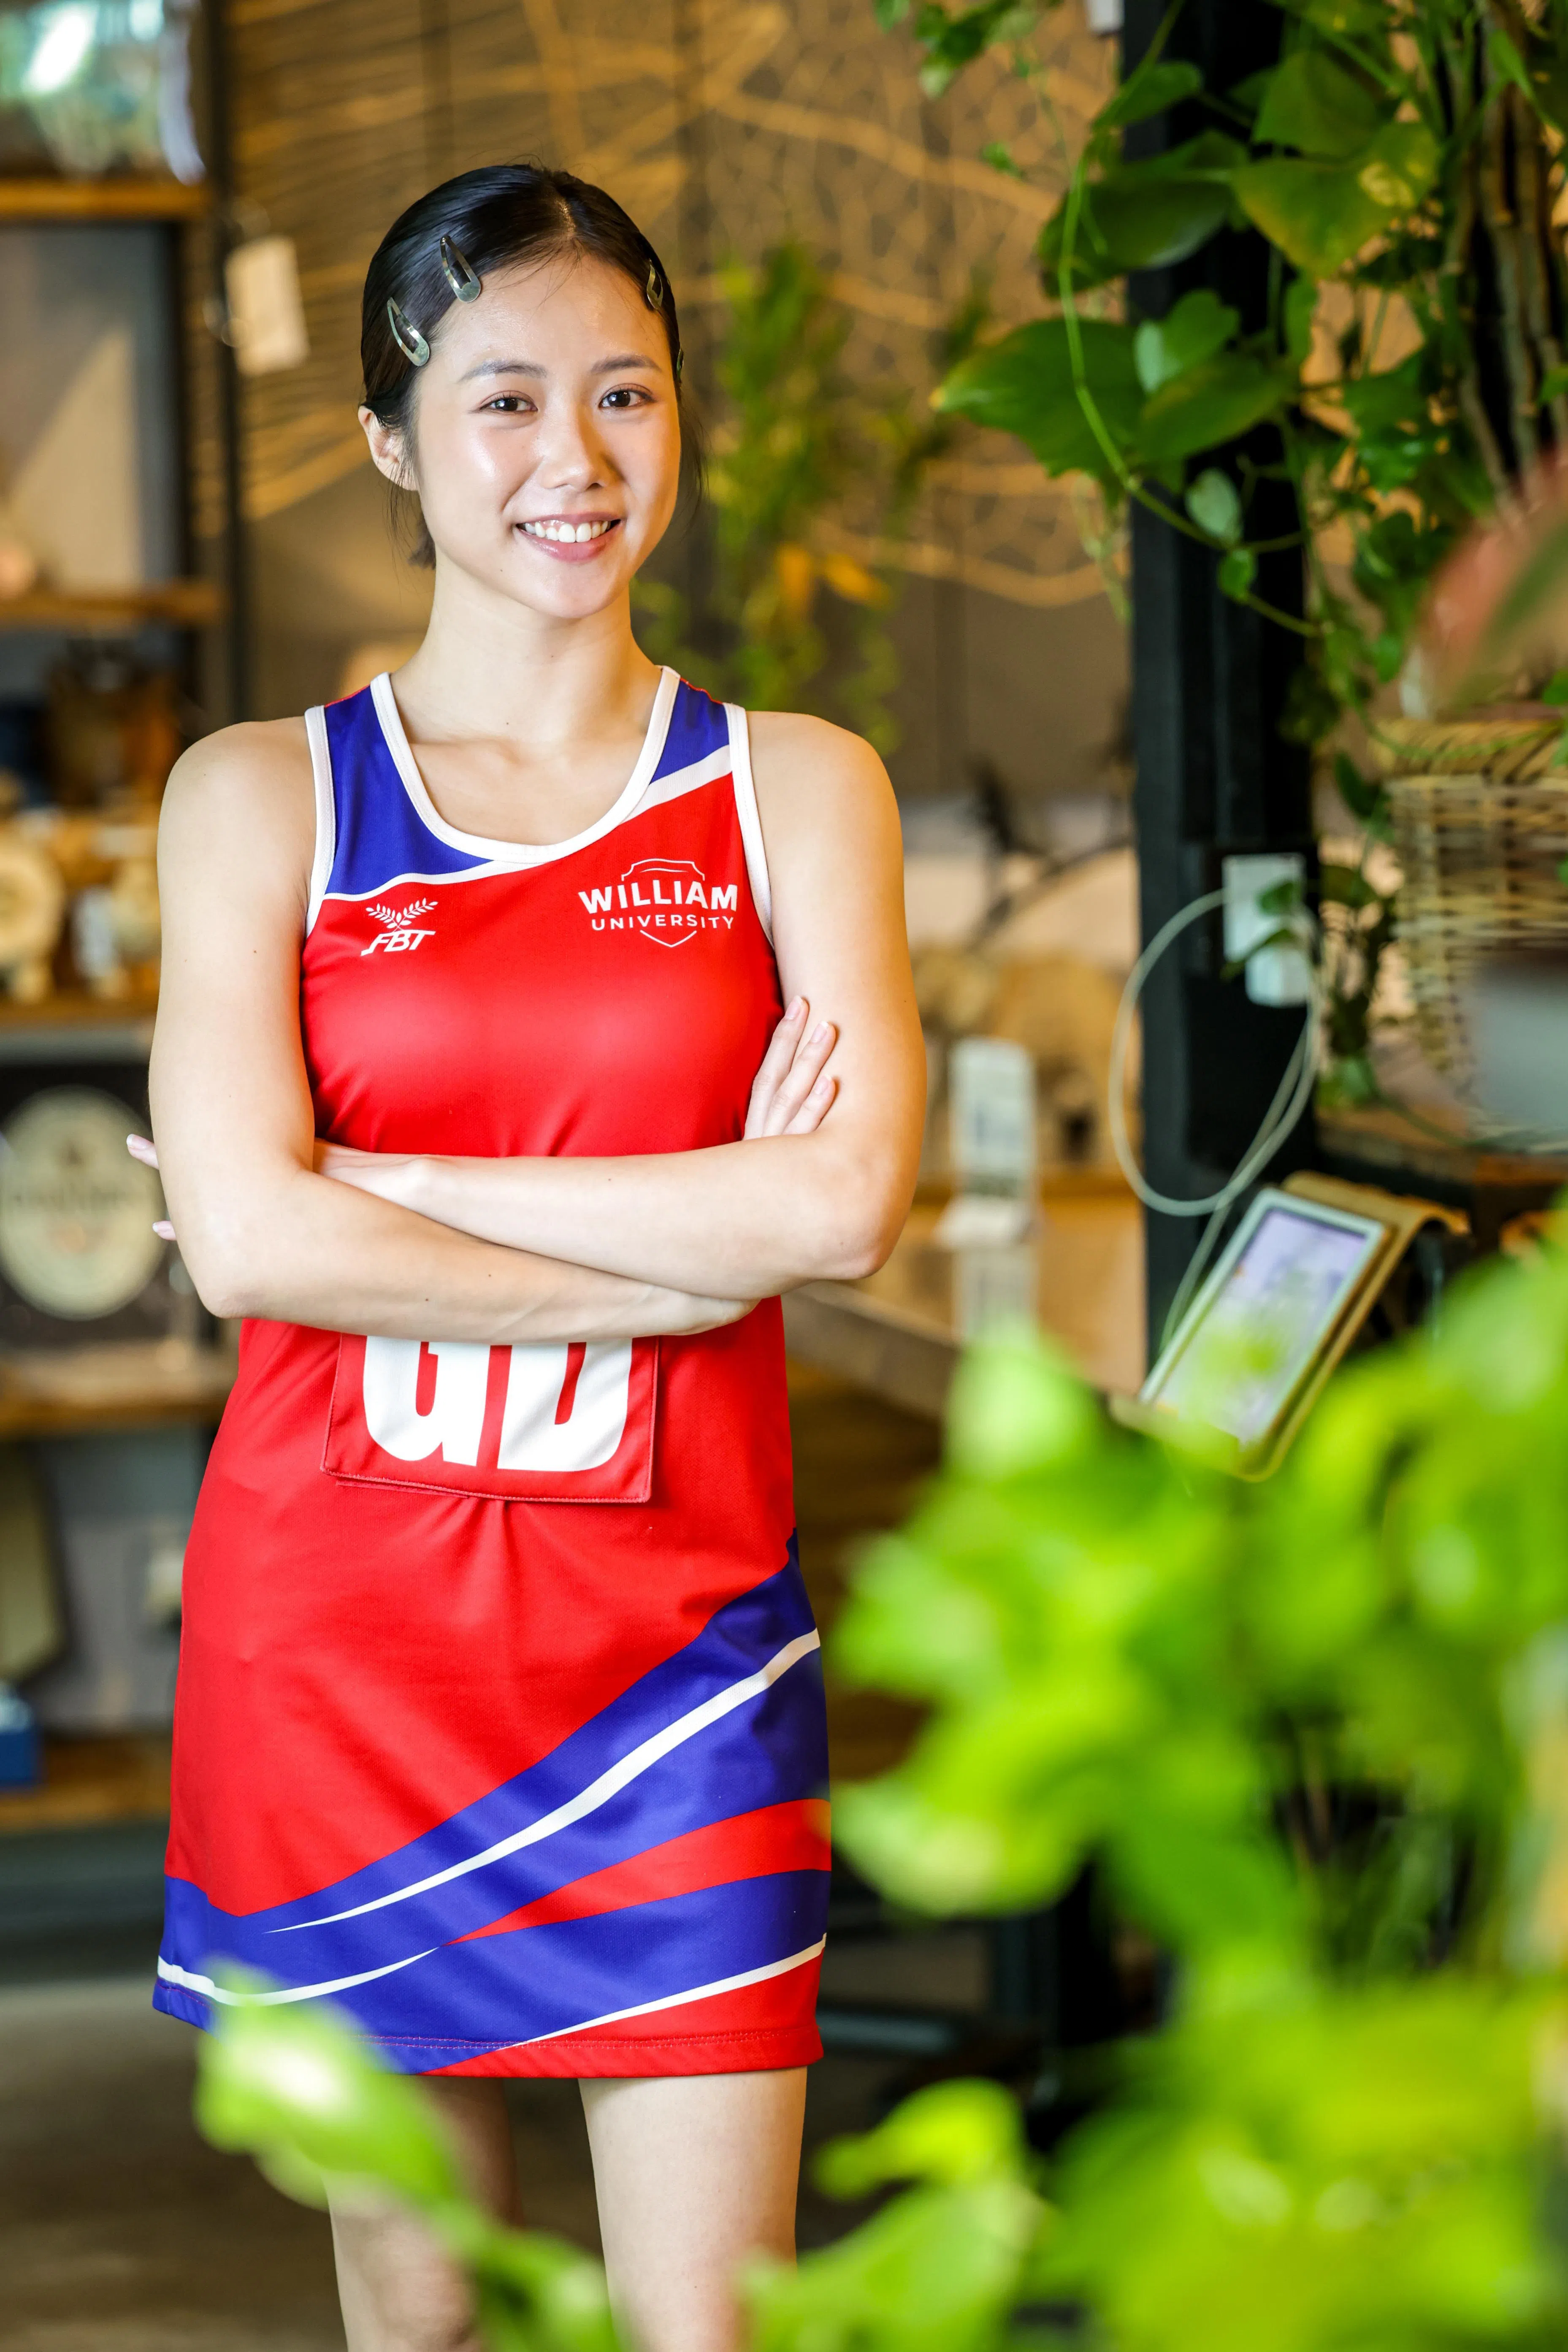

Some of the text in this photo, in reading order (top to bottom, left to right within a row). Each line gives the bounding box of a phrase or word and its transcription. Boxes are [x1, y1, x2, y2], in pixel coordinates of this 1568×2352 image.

[578, 880, 738, 914] WILLIAM
[592, 914, 734, 931] UNIVERSITY
[360, 929, 436, 957] FBT
